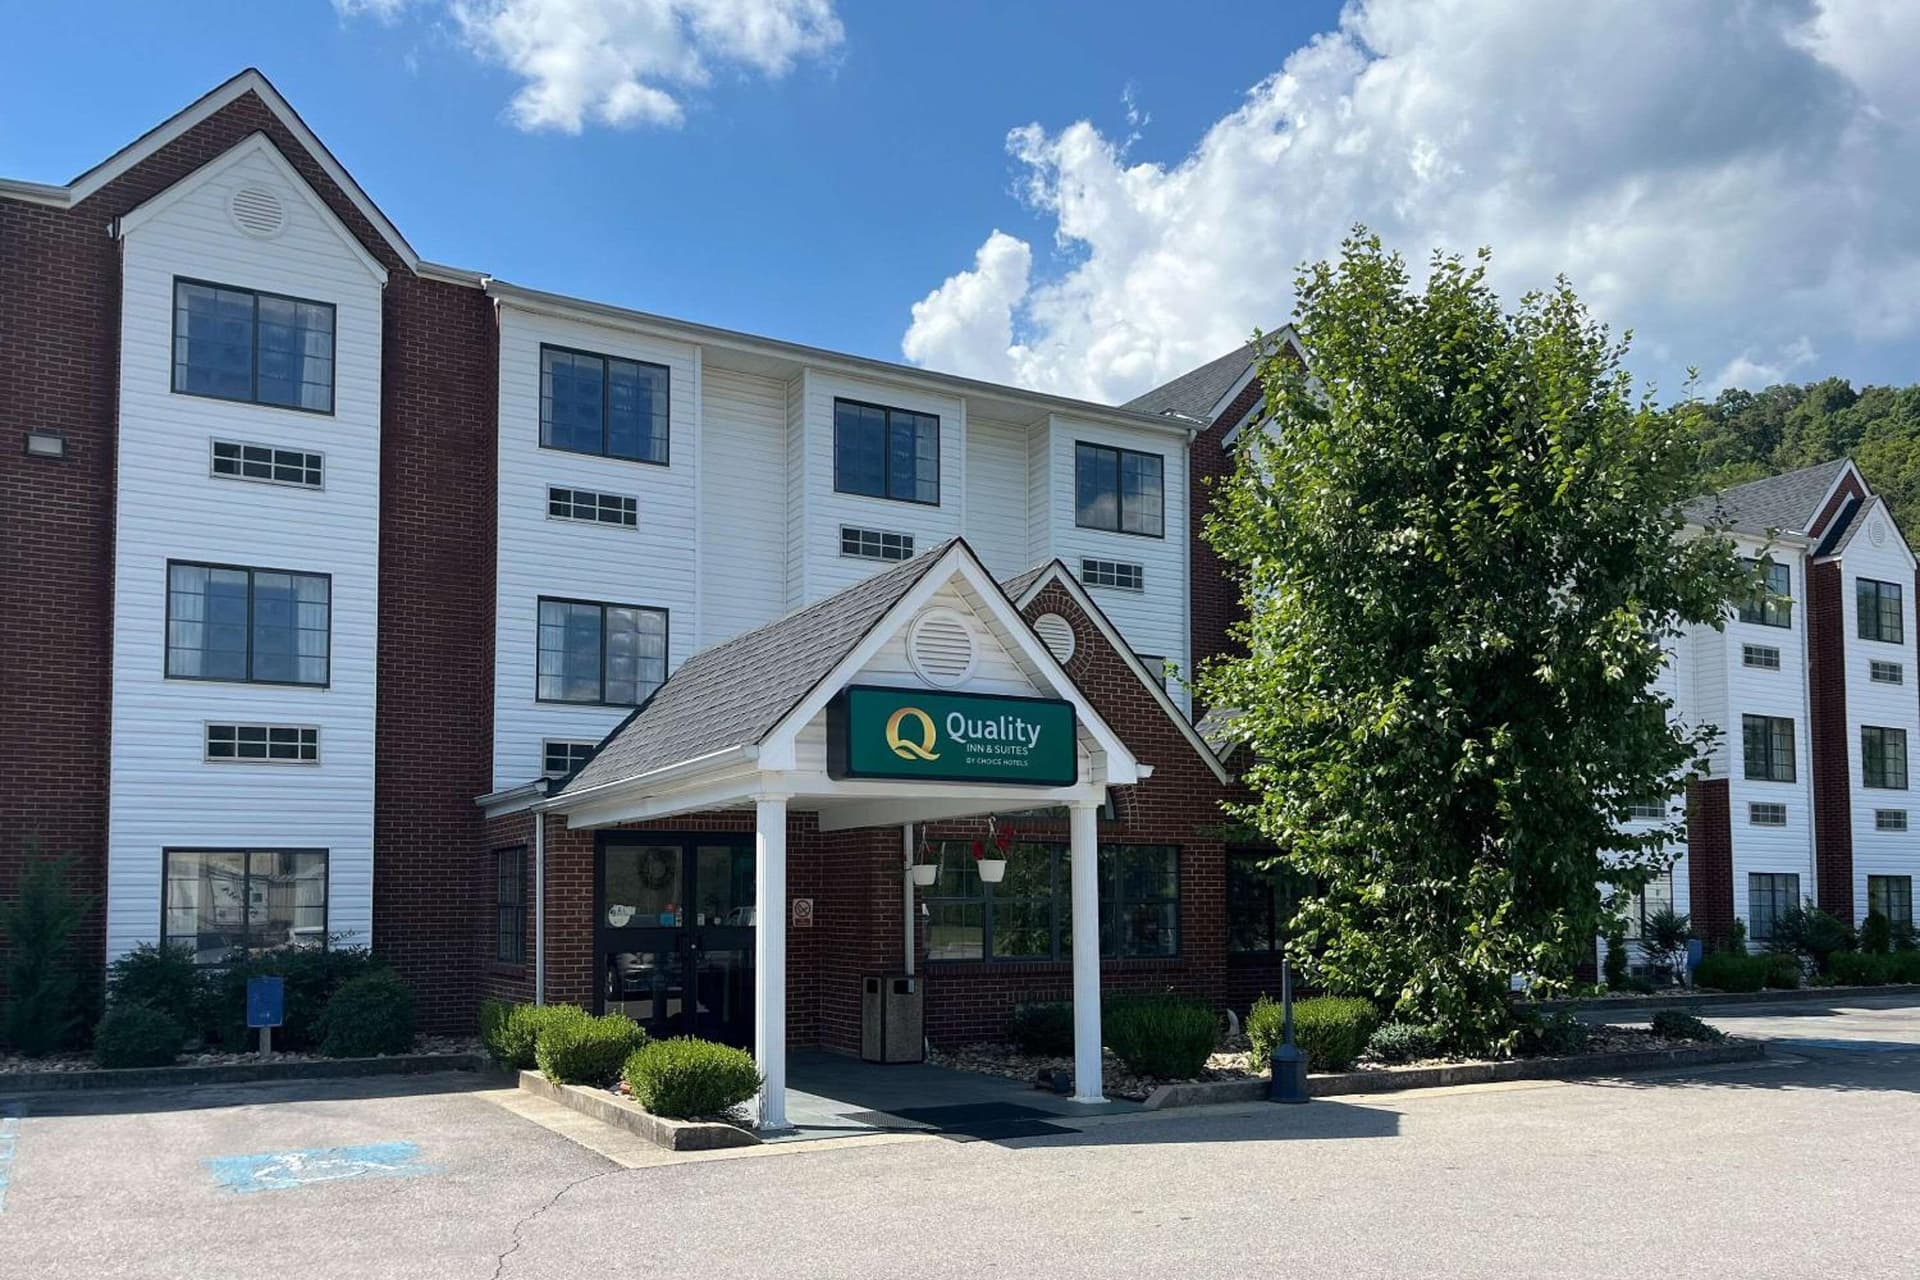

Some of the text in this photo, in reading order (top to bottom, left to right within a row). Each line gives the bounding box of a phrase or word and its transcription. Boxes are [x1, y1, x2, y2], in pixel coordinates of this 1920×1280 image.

[946, 712, 1041, 748] Quality
[966, 743, 1029, 756] INN & SUITES
[976, 757, 1002, 766] CHOICE
[1003, 759, 1029, 767] HOTELS
